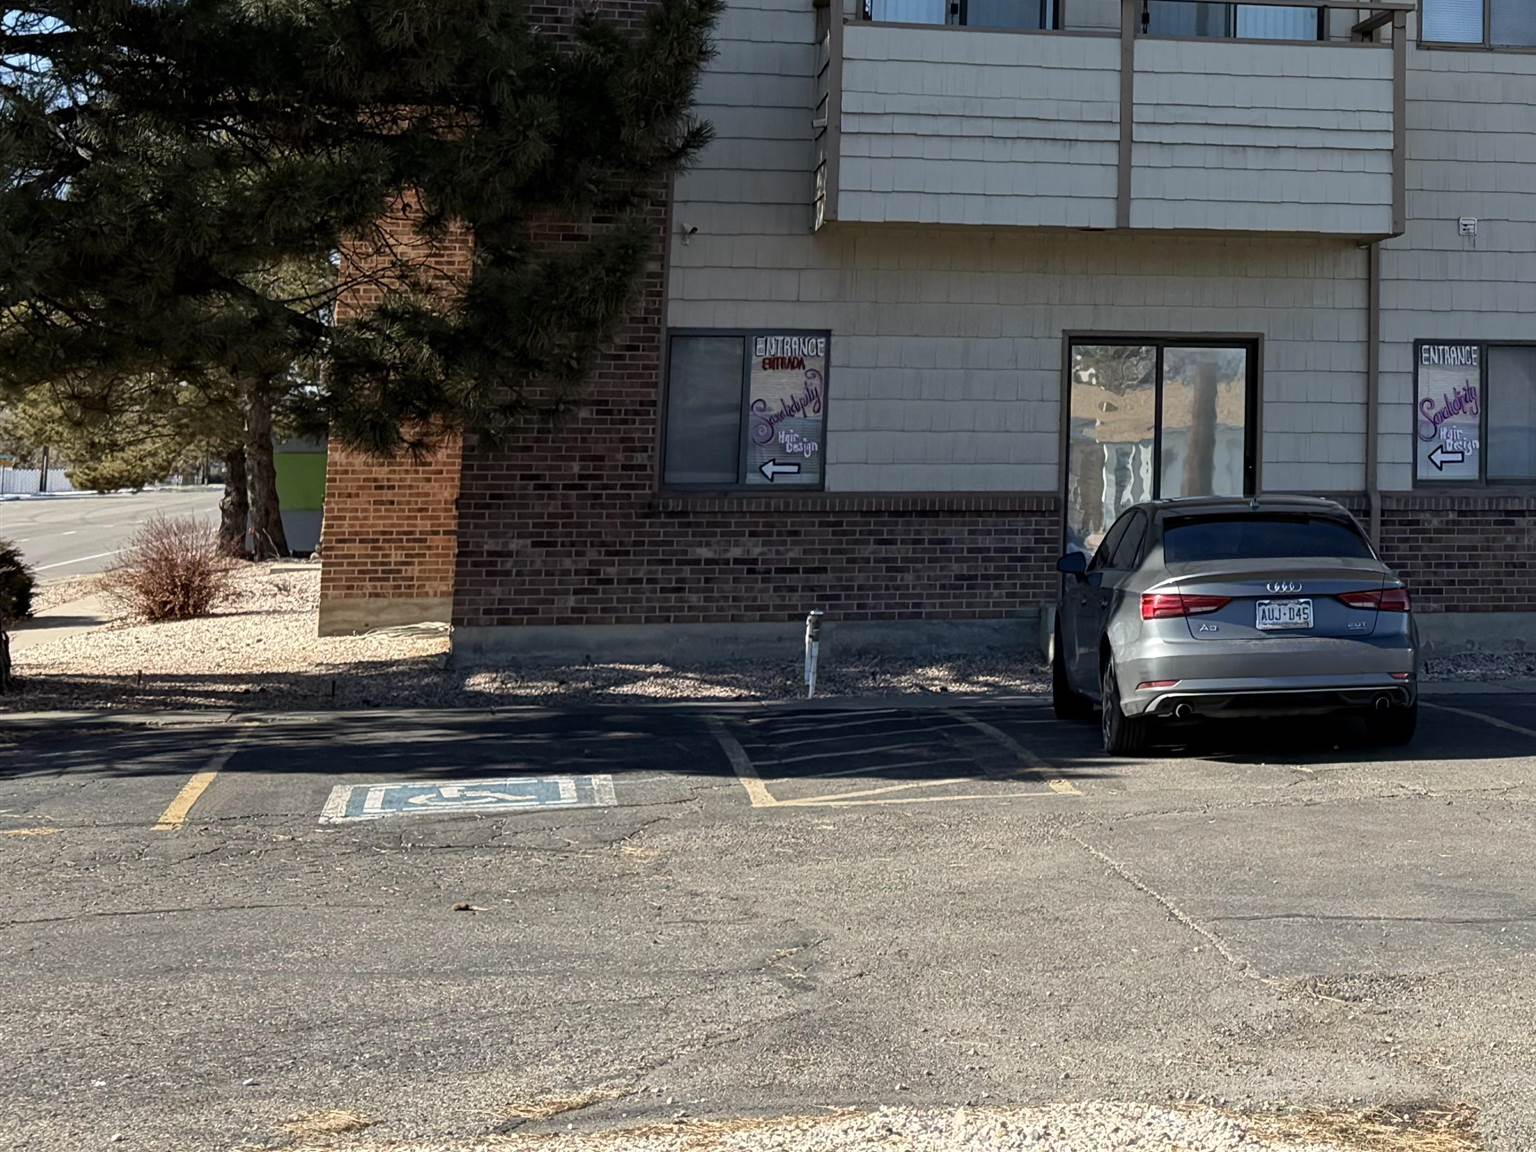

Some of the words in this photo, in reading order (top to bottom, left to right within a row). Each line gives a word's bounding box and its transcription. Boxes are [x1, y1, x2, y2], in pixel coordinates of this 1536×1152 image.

[754, 336, 826, 357] ENTRANCE
[1421, 345, 1478, 366] ENTRANCE
[762, 356, 806, 371] ENTRADA
[778, 429, 800, 445] Hair
[1439, 426, 1464, 441] Hair
[785, 438, 818, 458] Design
[1445, 437, 1480, 456] Design
